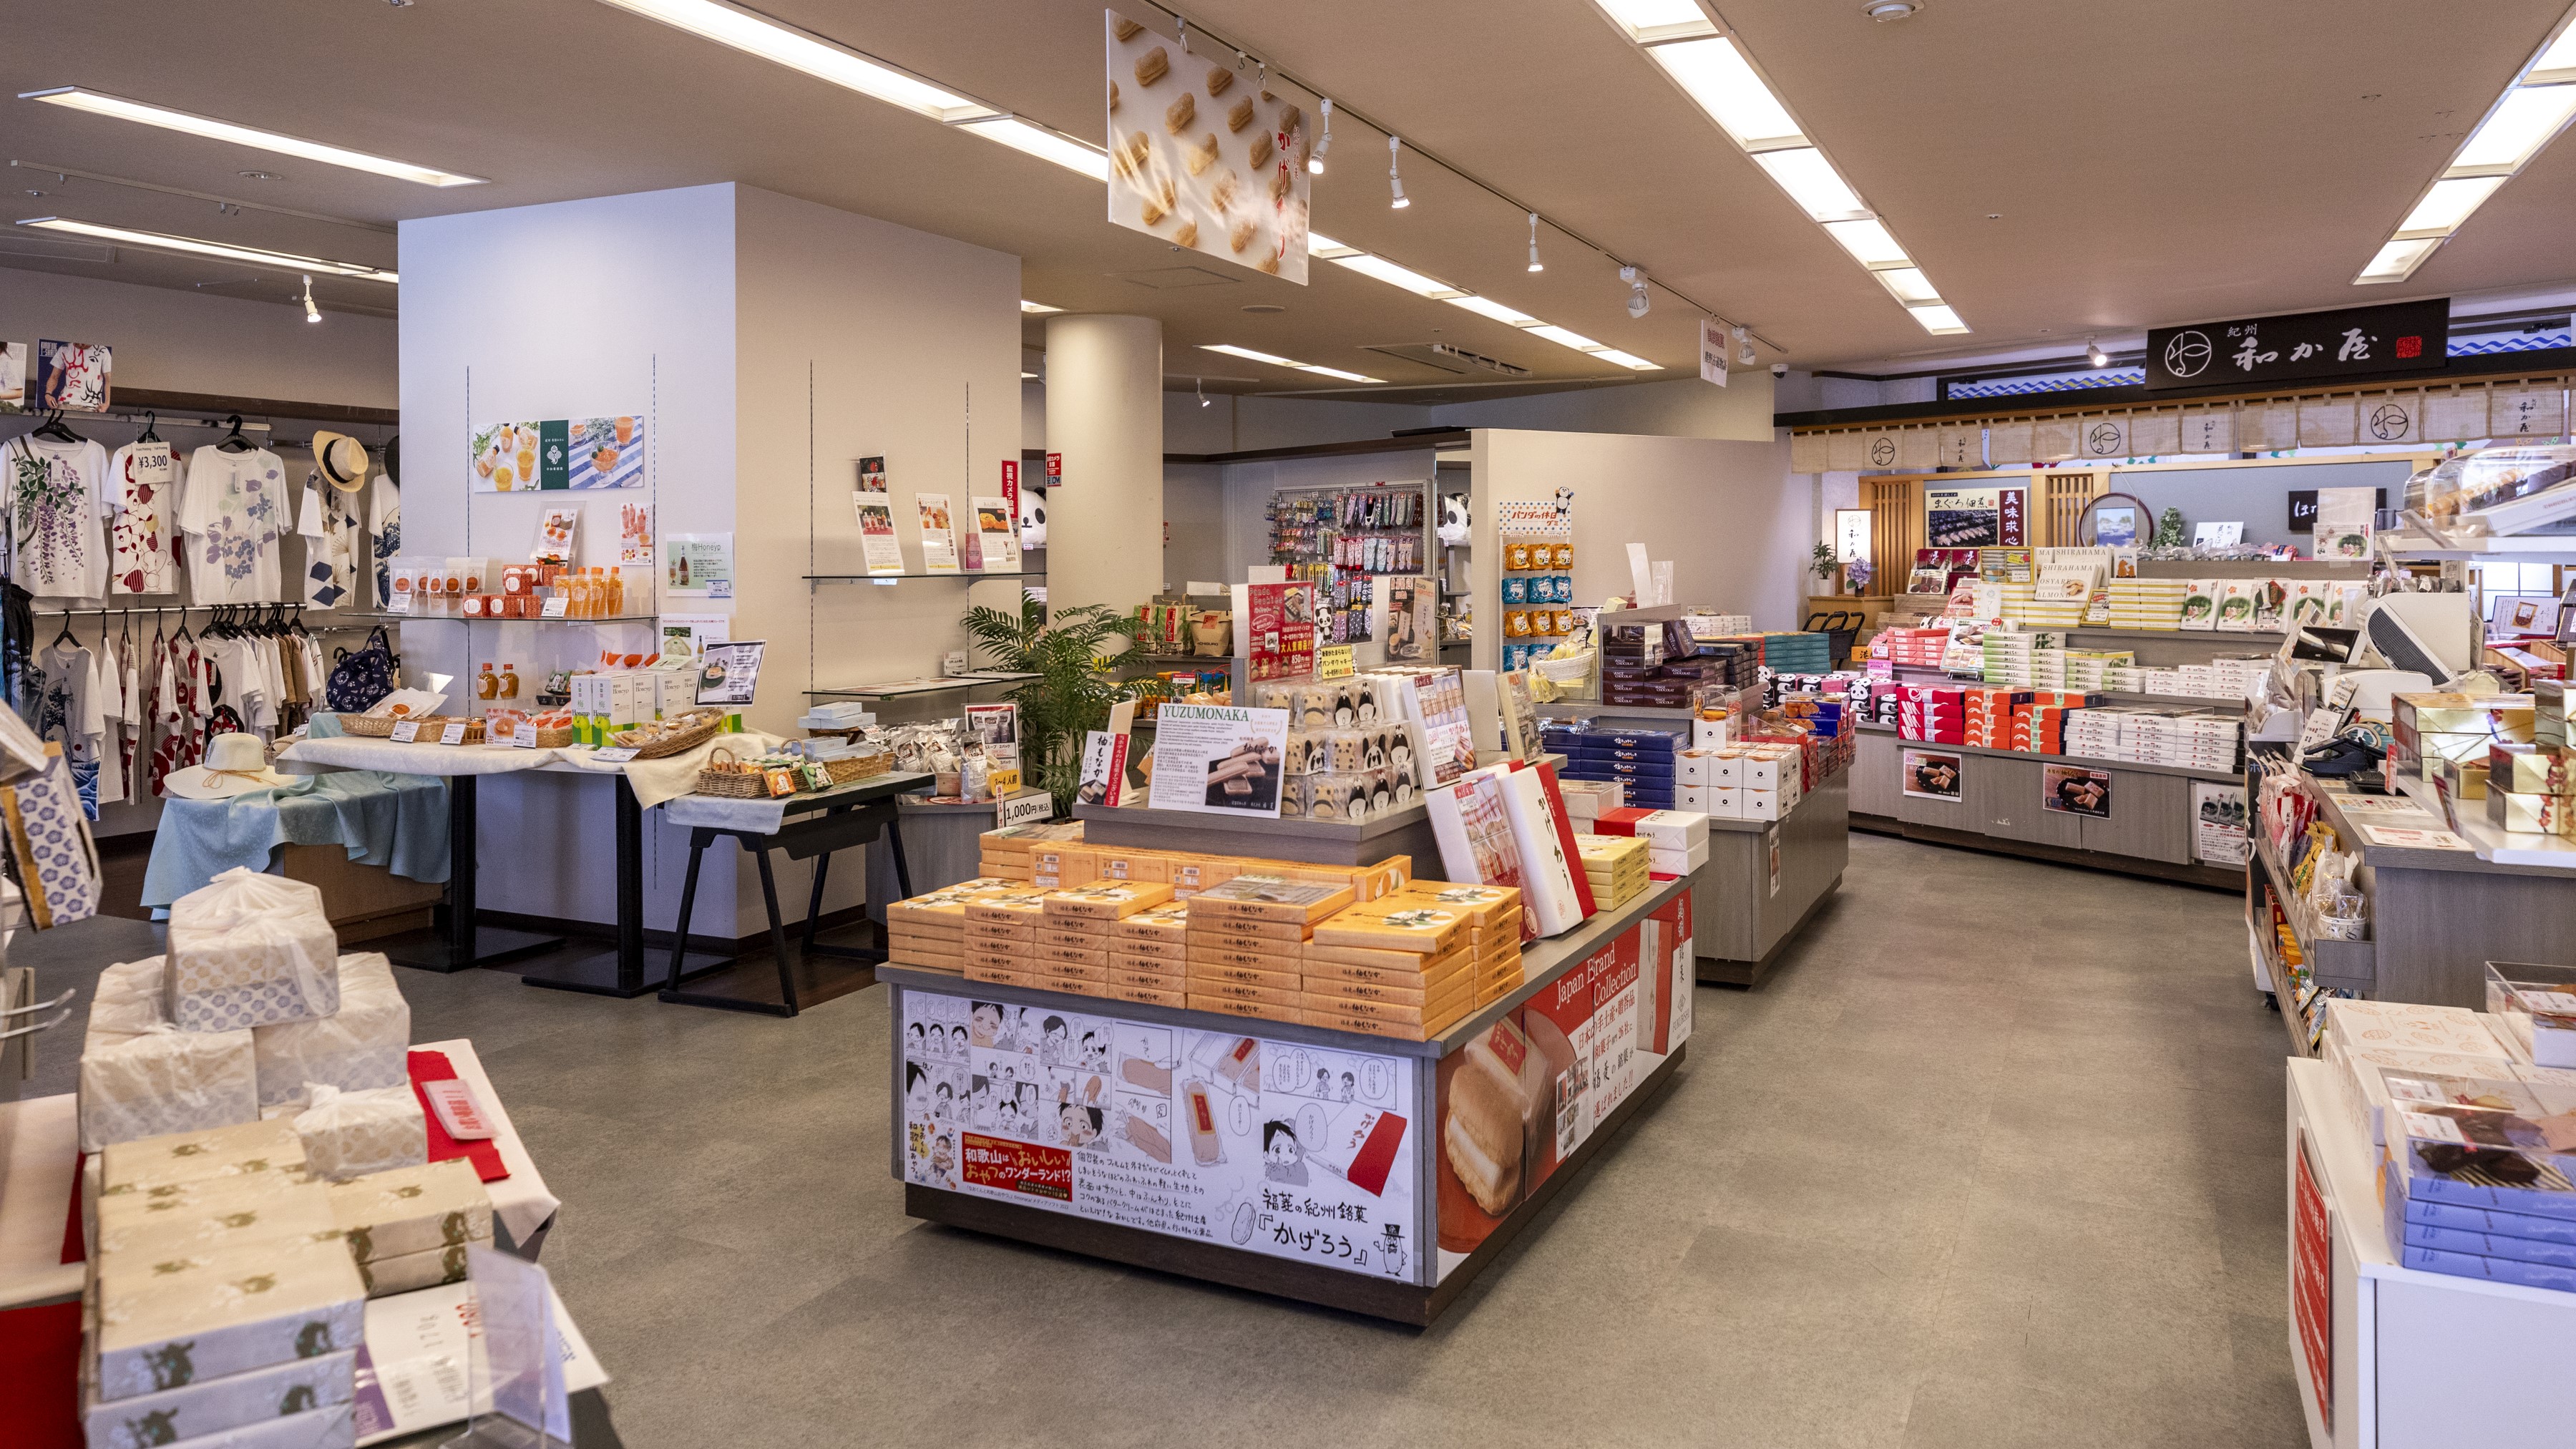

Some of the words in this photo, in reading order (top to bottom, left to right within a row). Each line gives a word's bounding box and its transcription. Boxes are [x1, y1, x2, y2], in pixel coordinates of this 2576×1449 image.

[2226, 323, 2258, 337] 紀州
[2231, 328, 2378, 371] 和か屋
[2518, 400, 2536, 434] 和か屋
[139, 454, 167, 469] ¥3,300
[1511, 510, 1558, 519] パンダの休日
[1933, 497, 1989, 509] まぐろ佃煮
[2004, 491, 2019, 546] 美味求心
[1249, 587, 1271, 596] Panda
[1253, 595, 1283, 605] Cookies
[1280, 640, 1312, 653] 大人気商品!!
[665, 681, 680, 690] Honeyp
[1163, 705, 1249, 722] YUZUMONAKA
[1093, 734, 1108, 778] 柚もなか
[1006, 799, 1051, 821] 1,000円(税込)
[1537, 796, 1570, 892] かげろう
[1556, 972, 1584, 1010] Japan
[1586, 941, 1615, 985] Brand
[1594, 962, 1636, 1007] Collection
[1579, 989, 1635, 1051] 日本の手土産・贈答品
[1594, 1069, 1634, 1118] 選ばれました!!
[1346, 1113, 1375, 1149] かげろう
[965, 1148, 1010, 1165] 和歌山は
[1018, 1148, 1066, 1167] おいしい
[965, 1163, 1072, 1185] おやつのワンダーランド!?
[1262, 1188, 1369, 1224] 福菱の紀州銘菓
[1259, 1214, 1368, 1266] 『かげろう』
